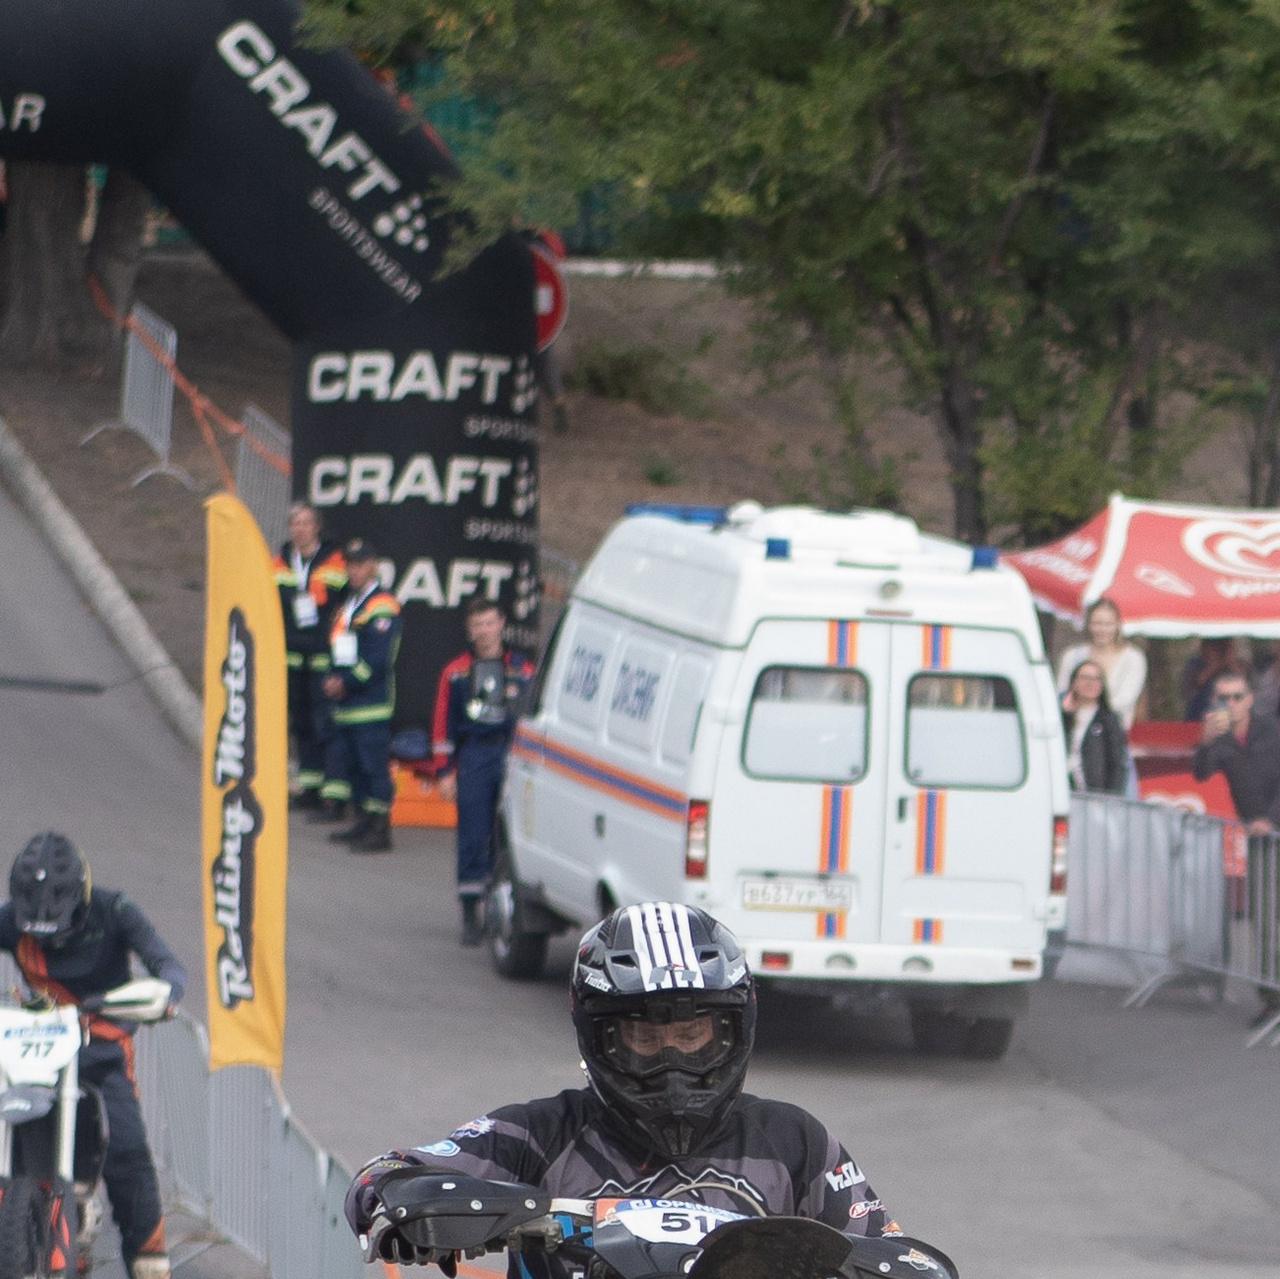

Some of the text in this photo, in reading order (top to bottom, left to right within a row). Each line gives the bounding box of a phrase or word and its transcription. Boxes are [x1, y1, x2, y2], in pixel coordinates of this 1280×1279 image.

[0, 93, 46, 132] R
[216, 19, 400, 200] CRAFT
[308, 186, 422, 303] SPORTSWEAR
[308, 350, 512, 404] CRAFT
[308, 453, 512, 507] CRAFT
[213, 620, 255, 1007] Rolling Moto
[20, 1041, 55, 1059] 717
